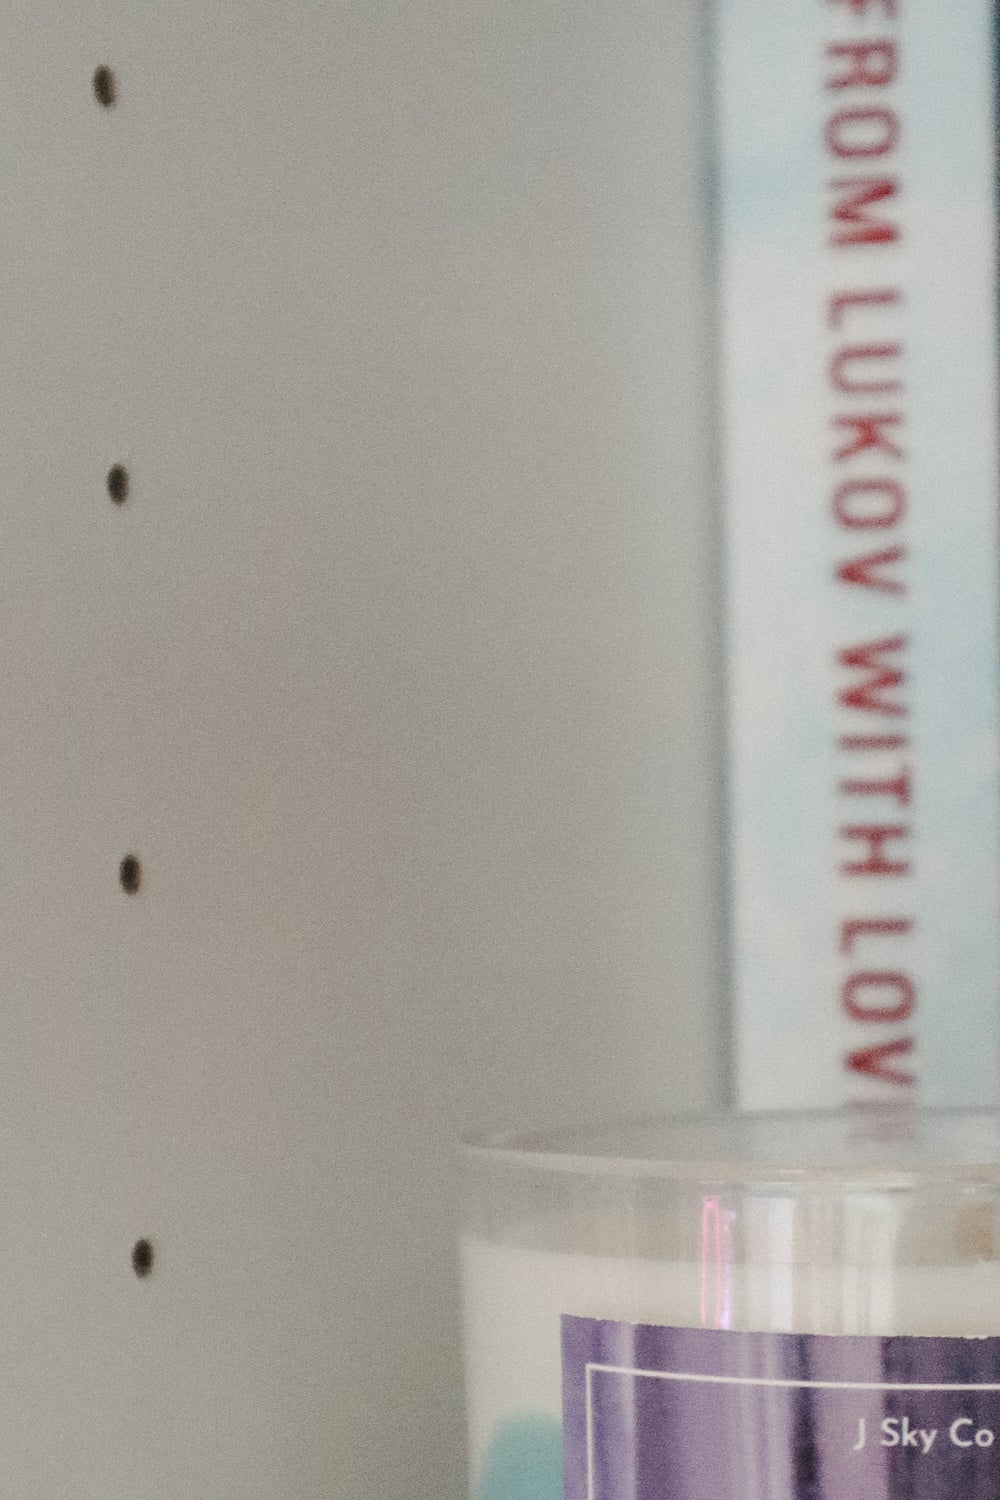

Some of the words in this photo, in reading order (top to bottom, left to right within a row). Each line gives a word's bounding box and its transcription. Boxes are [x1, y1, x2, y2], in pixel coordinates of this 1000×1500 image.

[829, 291, 908, 596] LUKOV
[835, 632, 911, 877] WITH
[853, 1416, 866, 1451] J
[880, 1416, 938, 1454] Sky
[950, 1417, 995, 1448] Co
